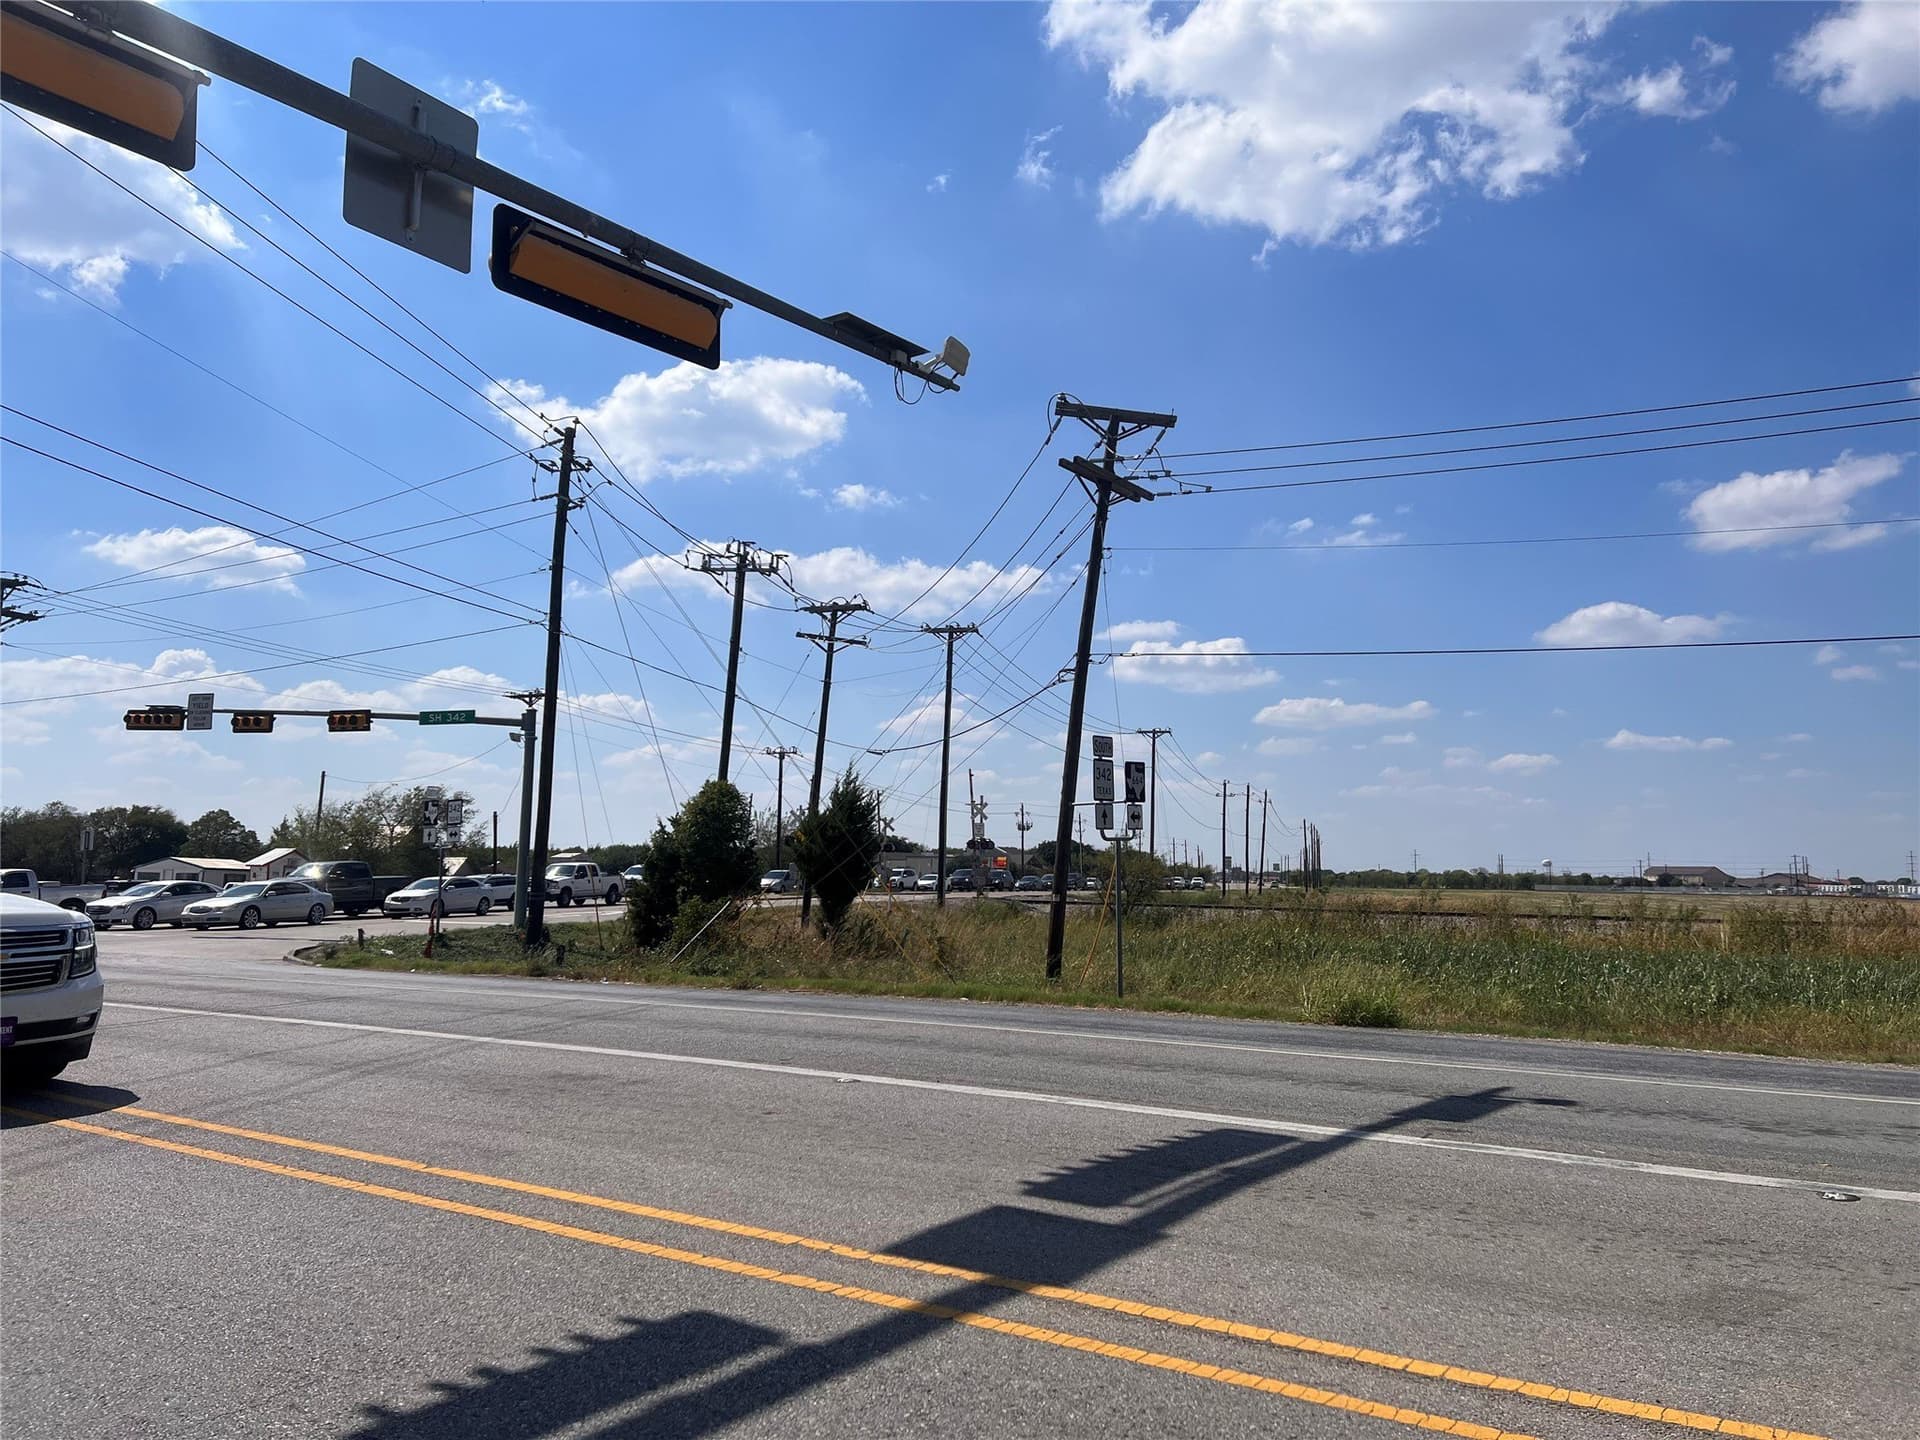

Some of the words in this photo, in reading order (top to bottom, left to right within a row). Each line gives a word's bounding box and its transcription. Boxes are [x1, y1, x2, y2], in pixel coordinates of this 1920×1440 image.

[428, 713, 442, 721] SH
[447, 712, 466, 721] 342
[1094, 739, 1112, 753] SOUTH
[1096, 767, 1112, 781] 342
[1096, 786, 1112, 795] TEXAS
